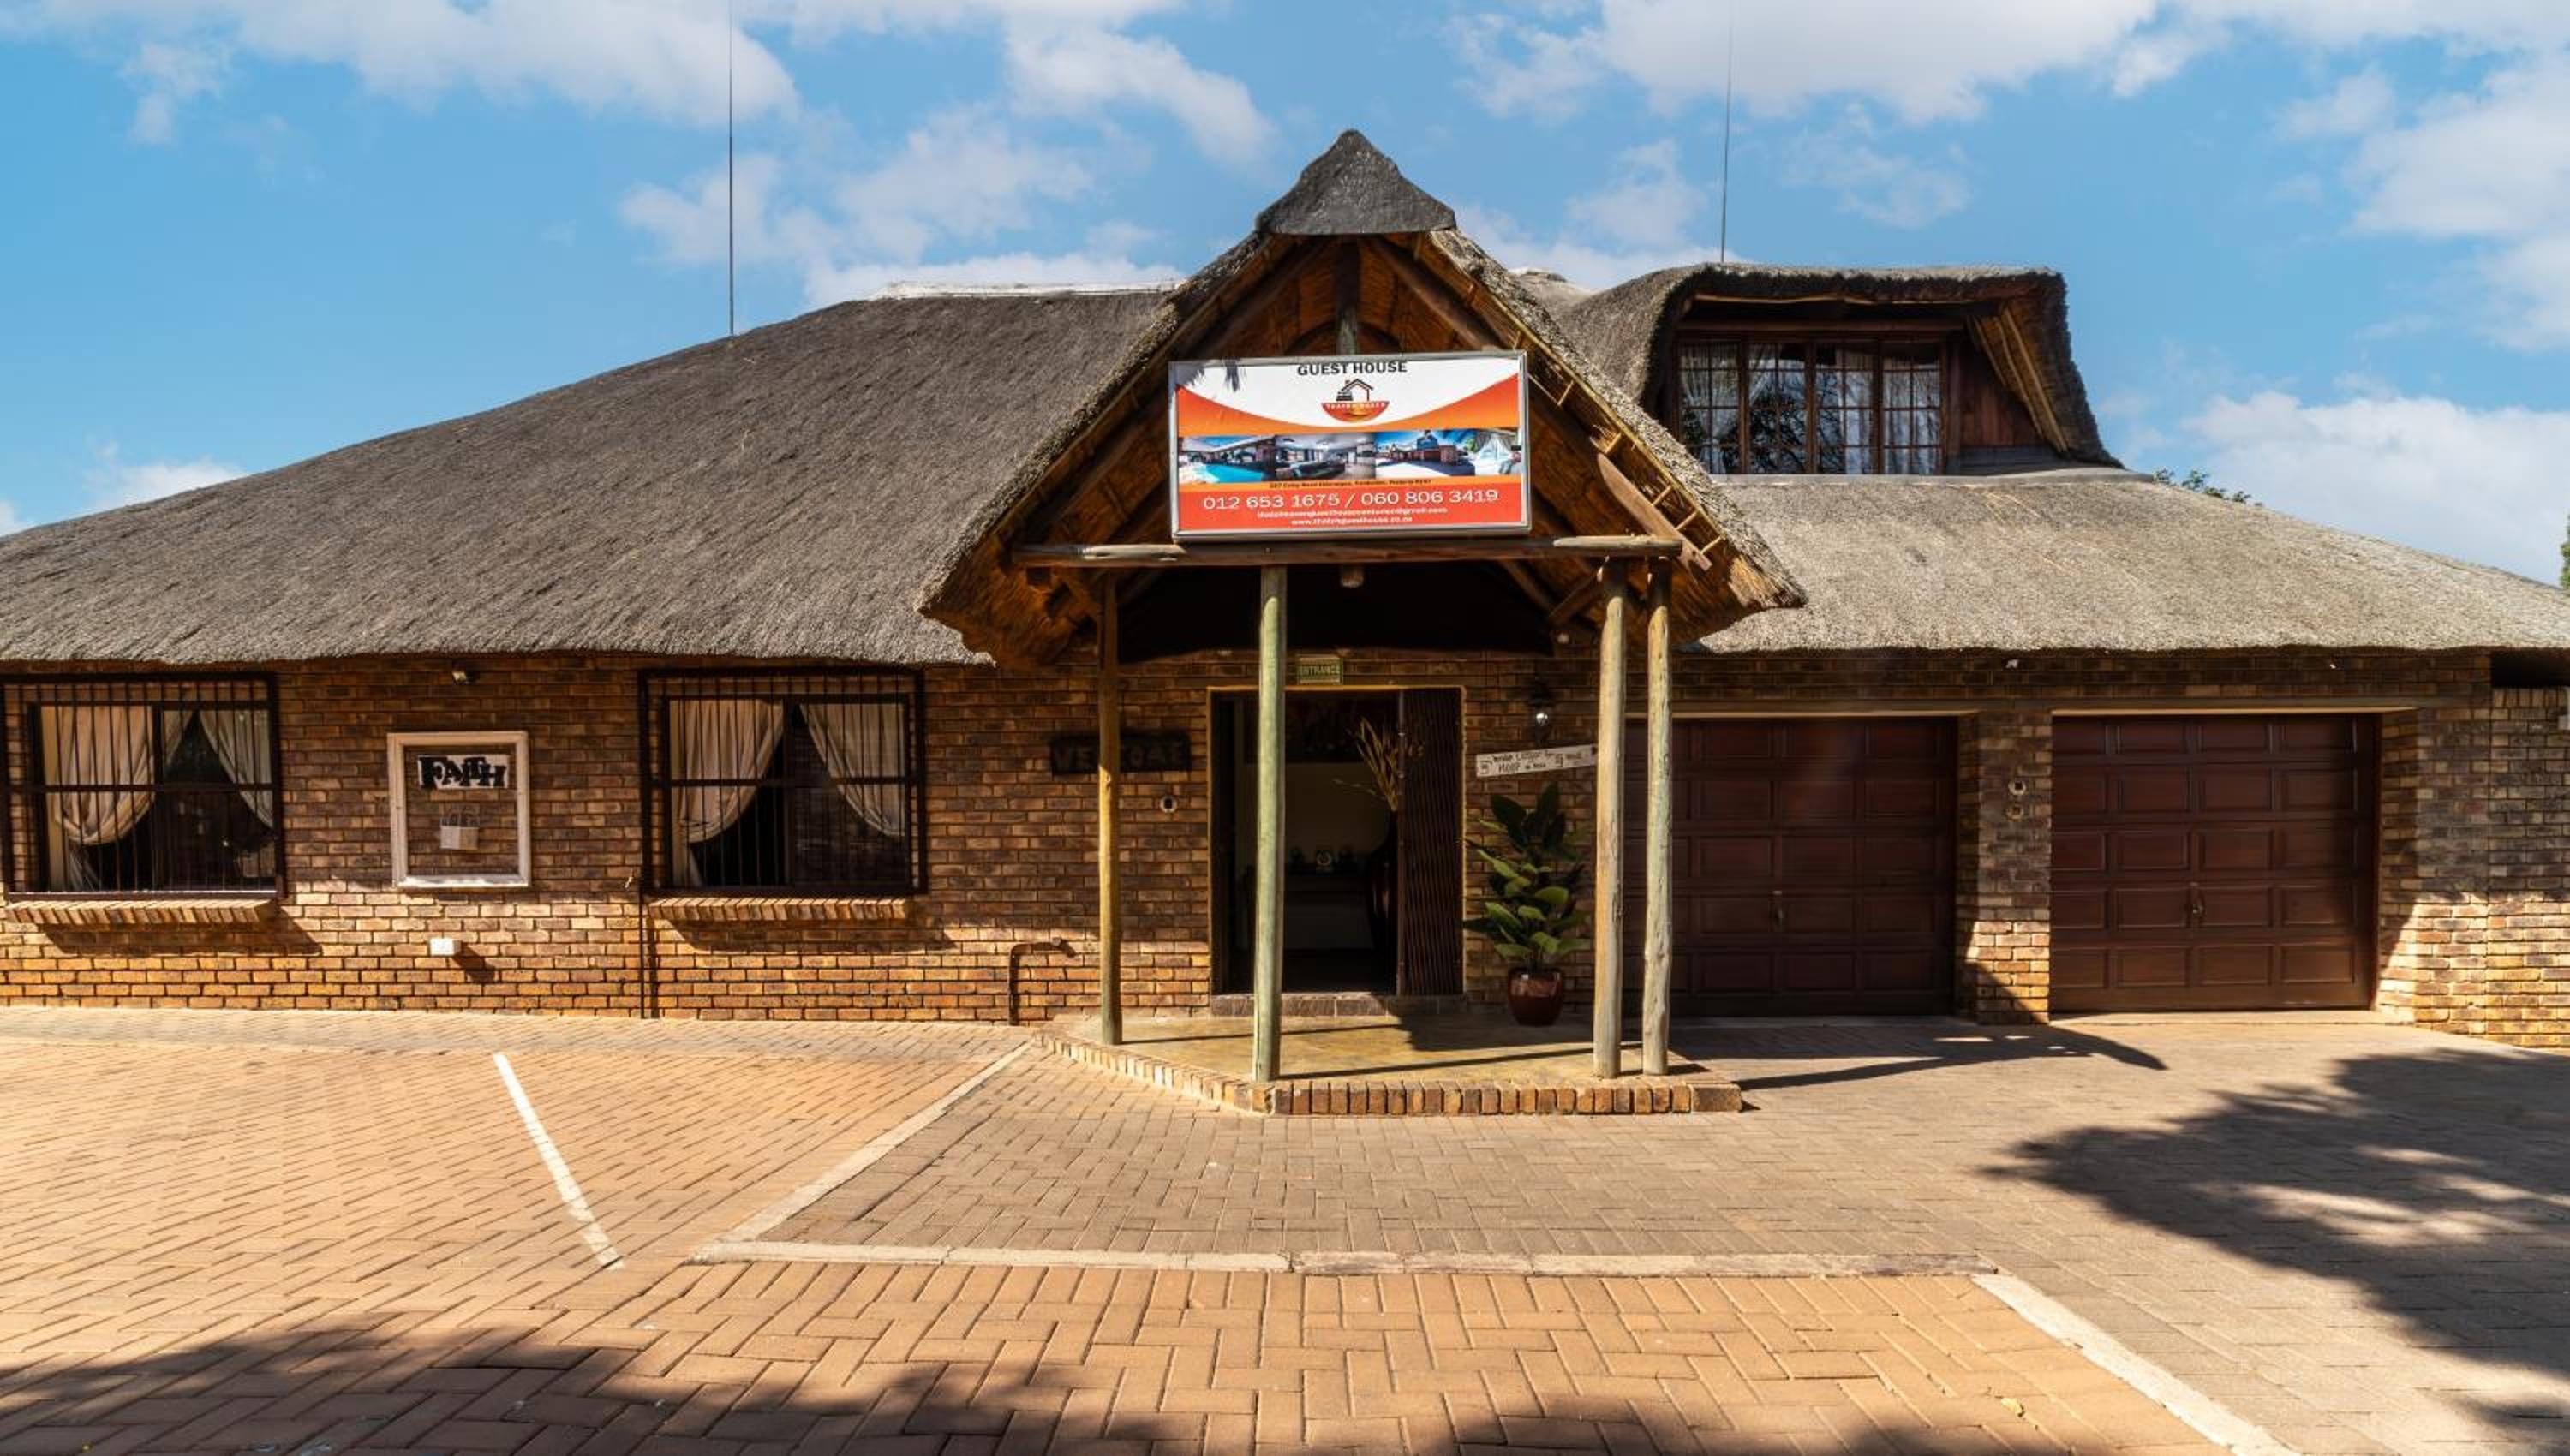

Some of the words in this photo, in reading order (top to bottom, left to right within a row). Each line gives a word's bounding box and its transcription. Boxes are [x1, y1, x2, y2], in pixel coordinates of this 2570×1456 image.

[1297, 362, 1349, 376] GUEST
[1354, 360, 1408, 373] HOUSE
[1203, 496, 1240, 510] 012
[1246, 495, 1284, 509] 653
[1291, 493, 1340, 508] 1675
[1344, 493, 1355, 507] /
[1360, 492, 1399, 505] 060
[1405, 491, 1443, 504] 806
[1449, 489, 1498, 503] 3419
[418, 756, 506, 790] FAITH
